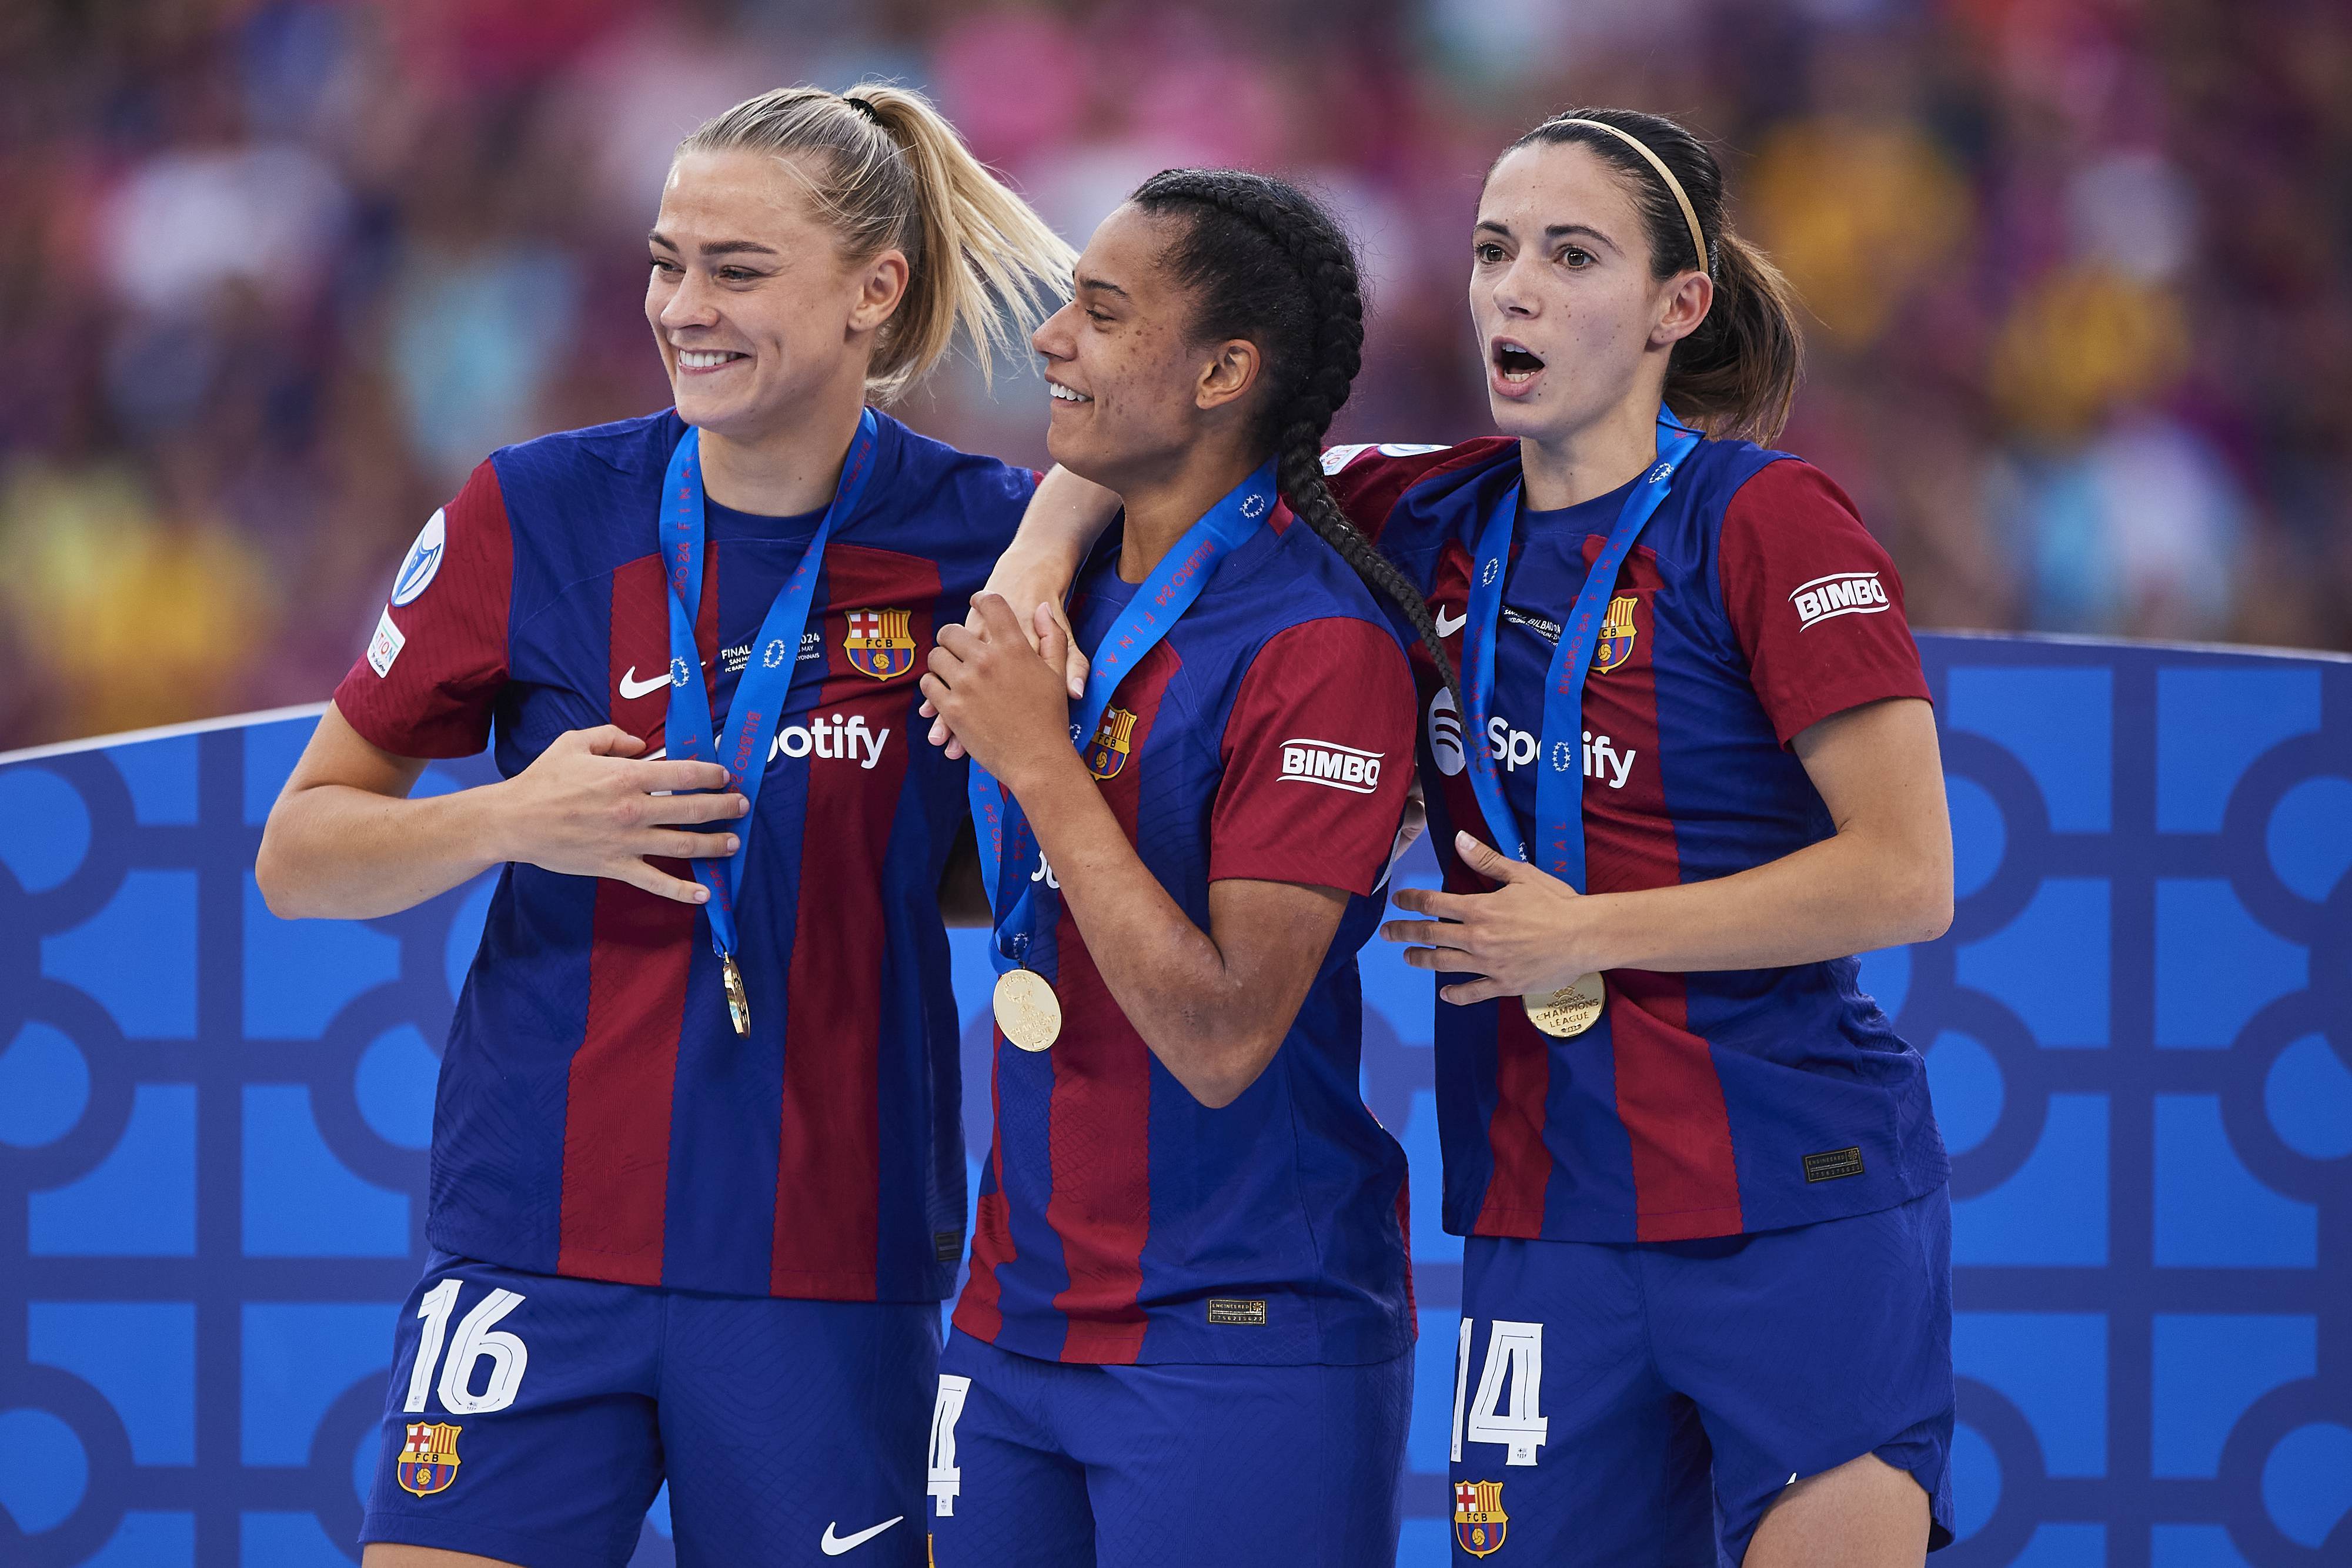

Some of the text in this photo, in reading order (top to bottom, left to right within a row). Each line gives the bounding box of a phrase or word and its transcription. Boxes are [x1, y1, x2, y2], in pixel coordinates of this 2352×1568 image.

[677, 542, 690, 563] 24
[1155, 585, 1176, 607] 24
[1794, 578, 1889, 622] BIMBO
[866, 638, 893, 648] FCB
[1095, 611, 1156, 678] FINAL
[1602, 628, 1616, 637] CB
[721, 633, 820, 660] FINAL 024
[715, 714, 890, 770] otify
[1097, 733, 1117, 747] FCB
[1487, 717, 1636, 788] Spify
[1281, 747, 1381, 786] BIMBO
[1552, 821, 1568, 872] NAL
[1536, 998, 1599, 1021] CHAMPIONS
[1549, 1011, 1590, 1028] LEAGUE
[403, 1279, 529, 1415] 16
[1450, 1317, 1548, 1467] 14
[415, 1453, 439, 1463] FCB
[1466, 1512, 1488, 1522] FCB
